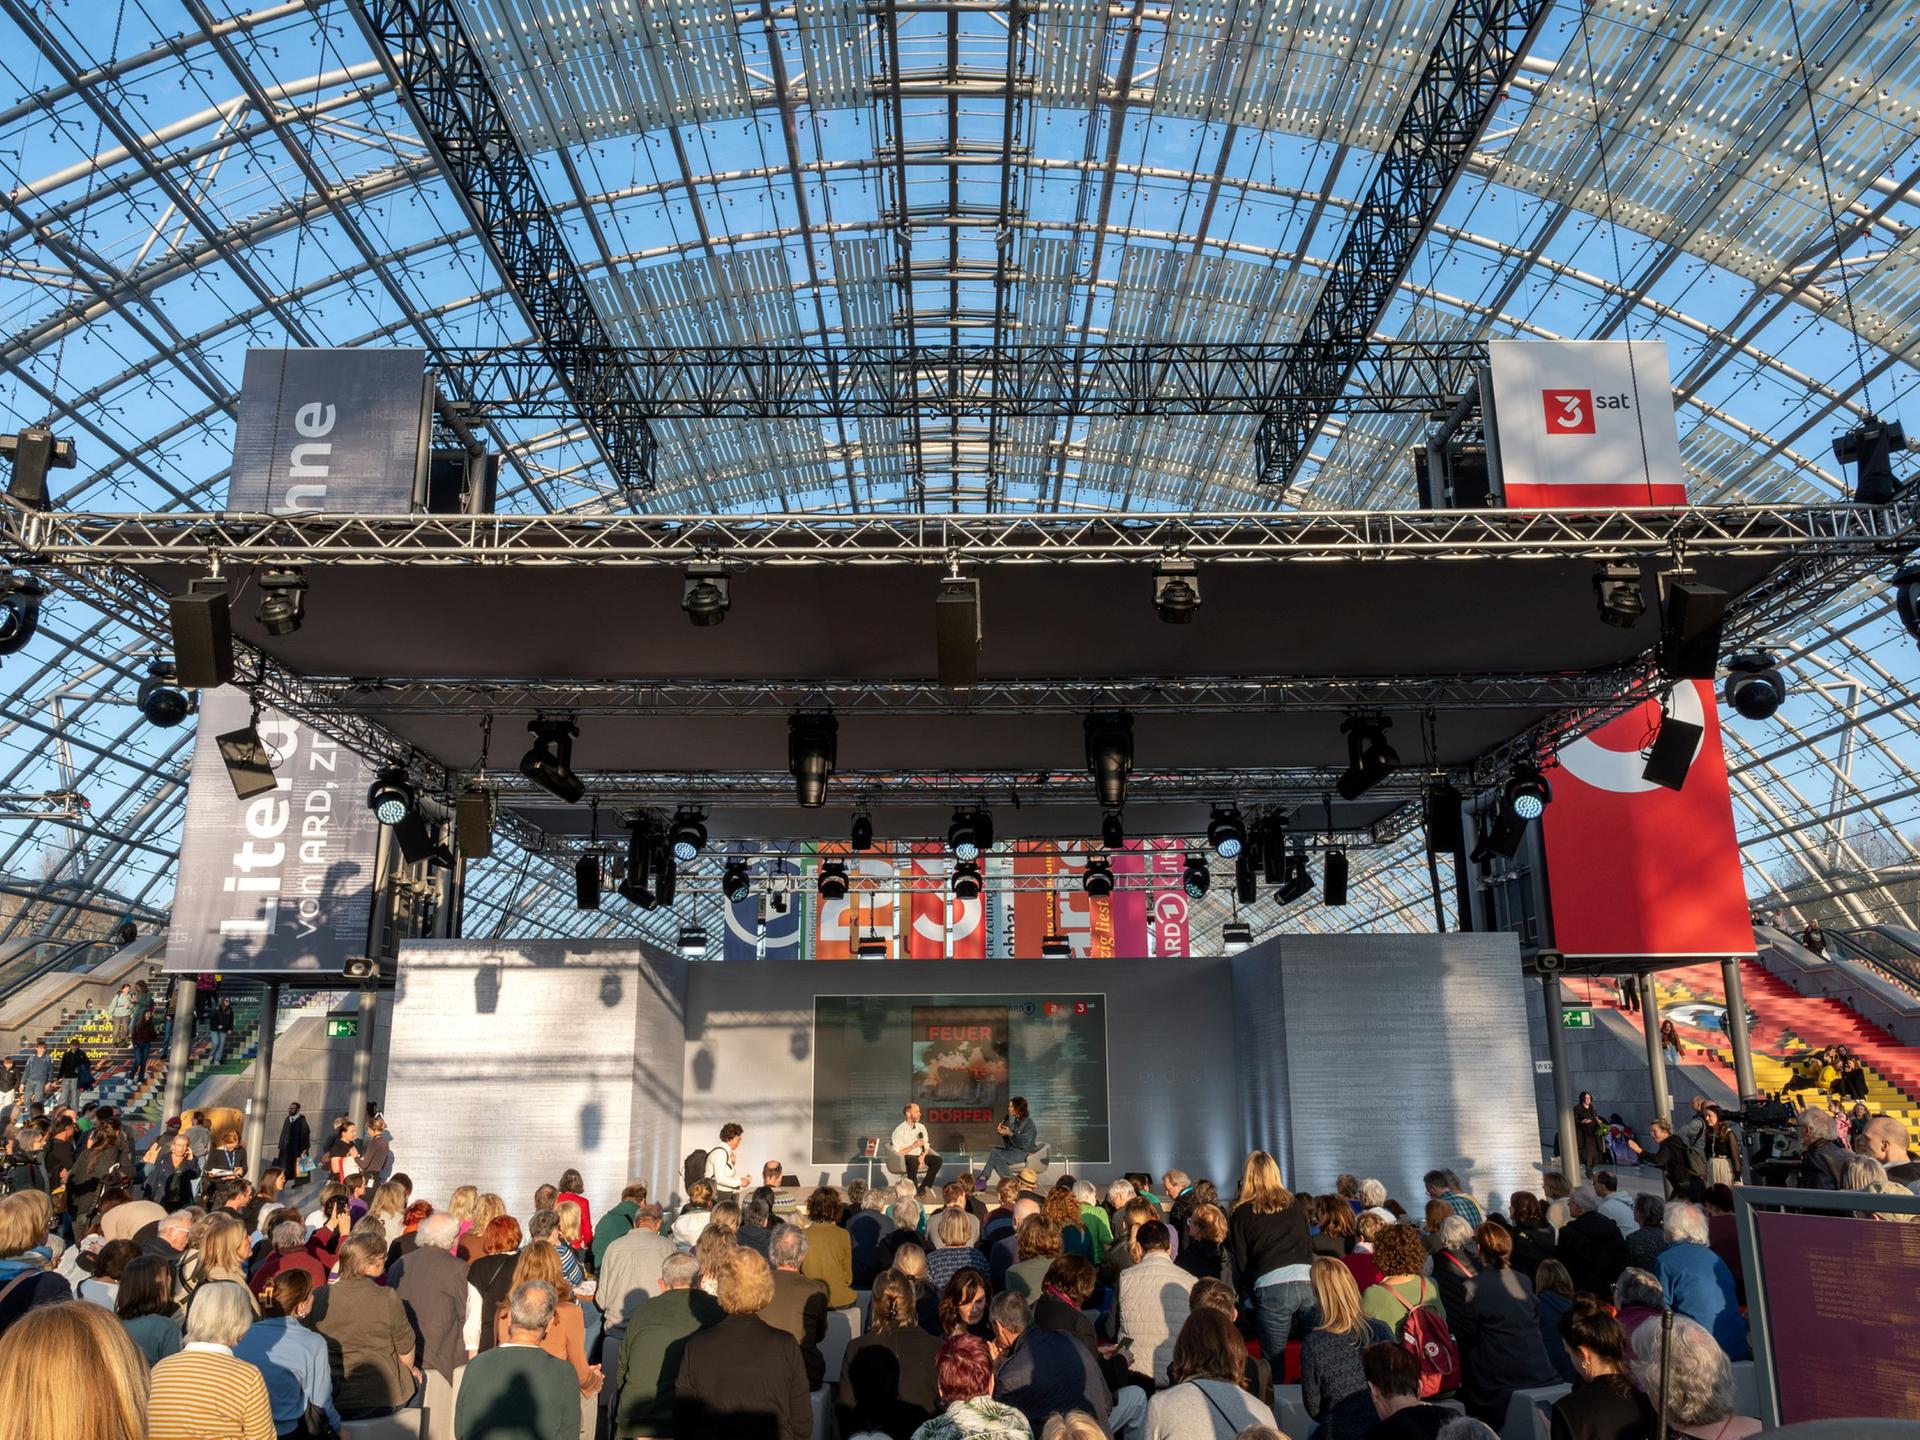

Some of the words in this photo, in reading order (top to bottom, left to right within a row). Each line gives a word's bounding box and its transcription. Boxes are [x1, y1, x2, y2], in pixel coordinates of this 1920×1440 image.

[1595, 392, 1631, 409] sat
[299, 780, 338, 864] ARD,
[296, 875, 321, 939] von
[1094, 900, 1110, 932] liest
[929, 1026, 992, 1041] FEUER
[928, 1108, 993, 1123] DÖRFER
